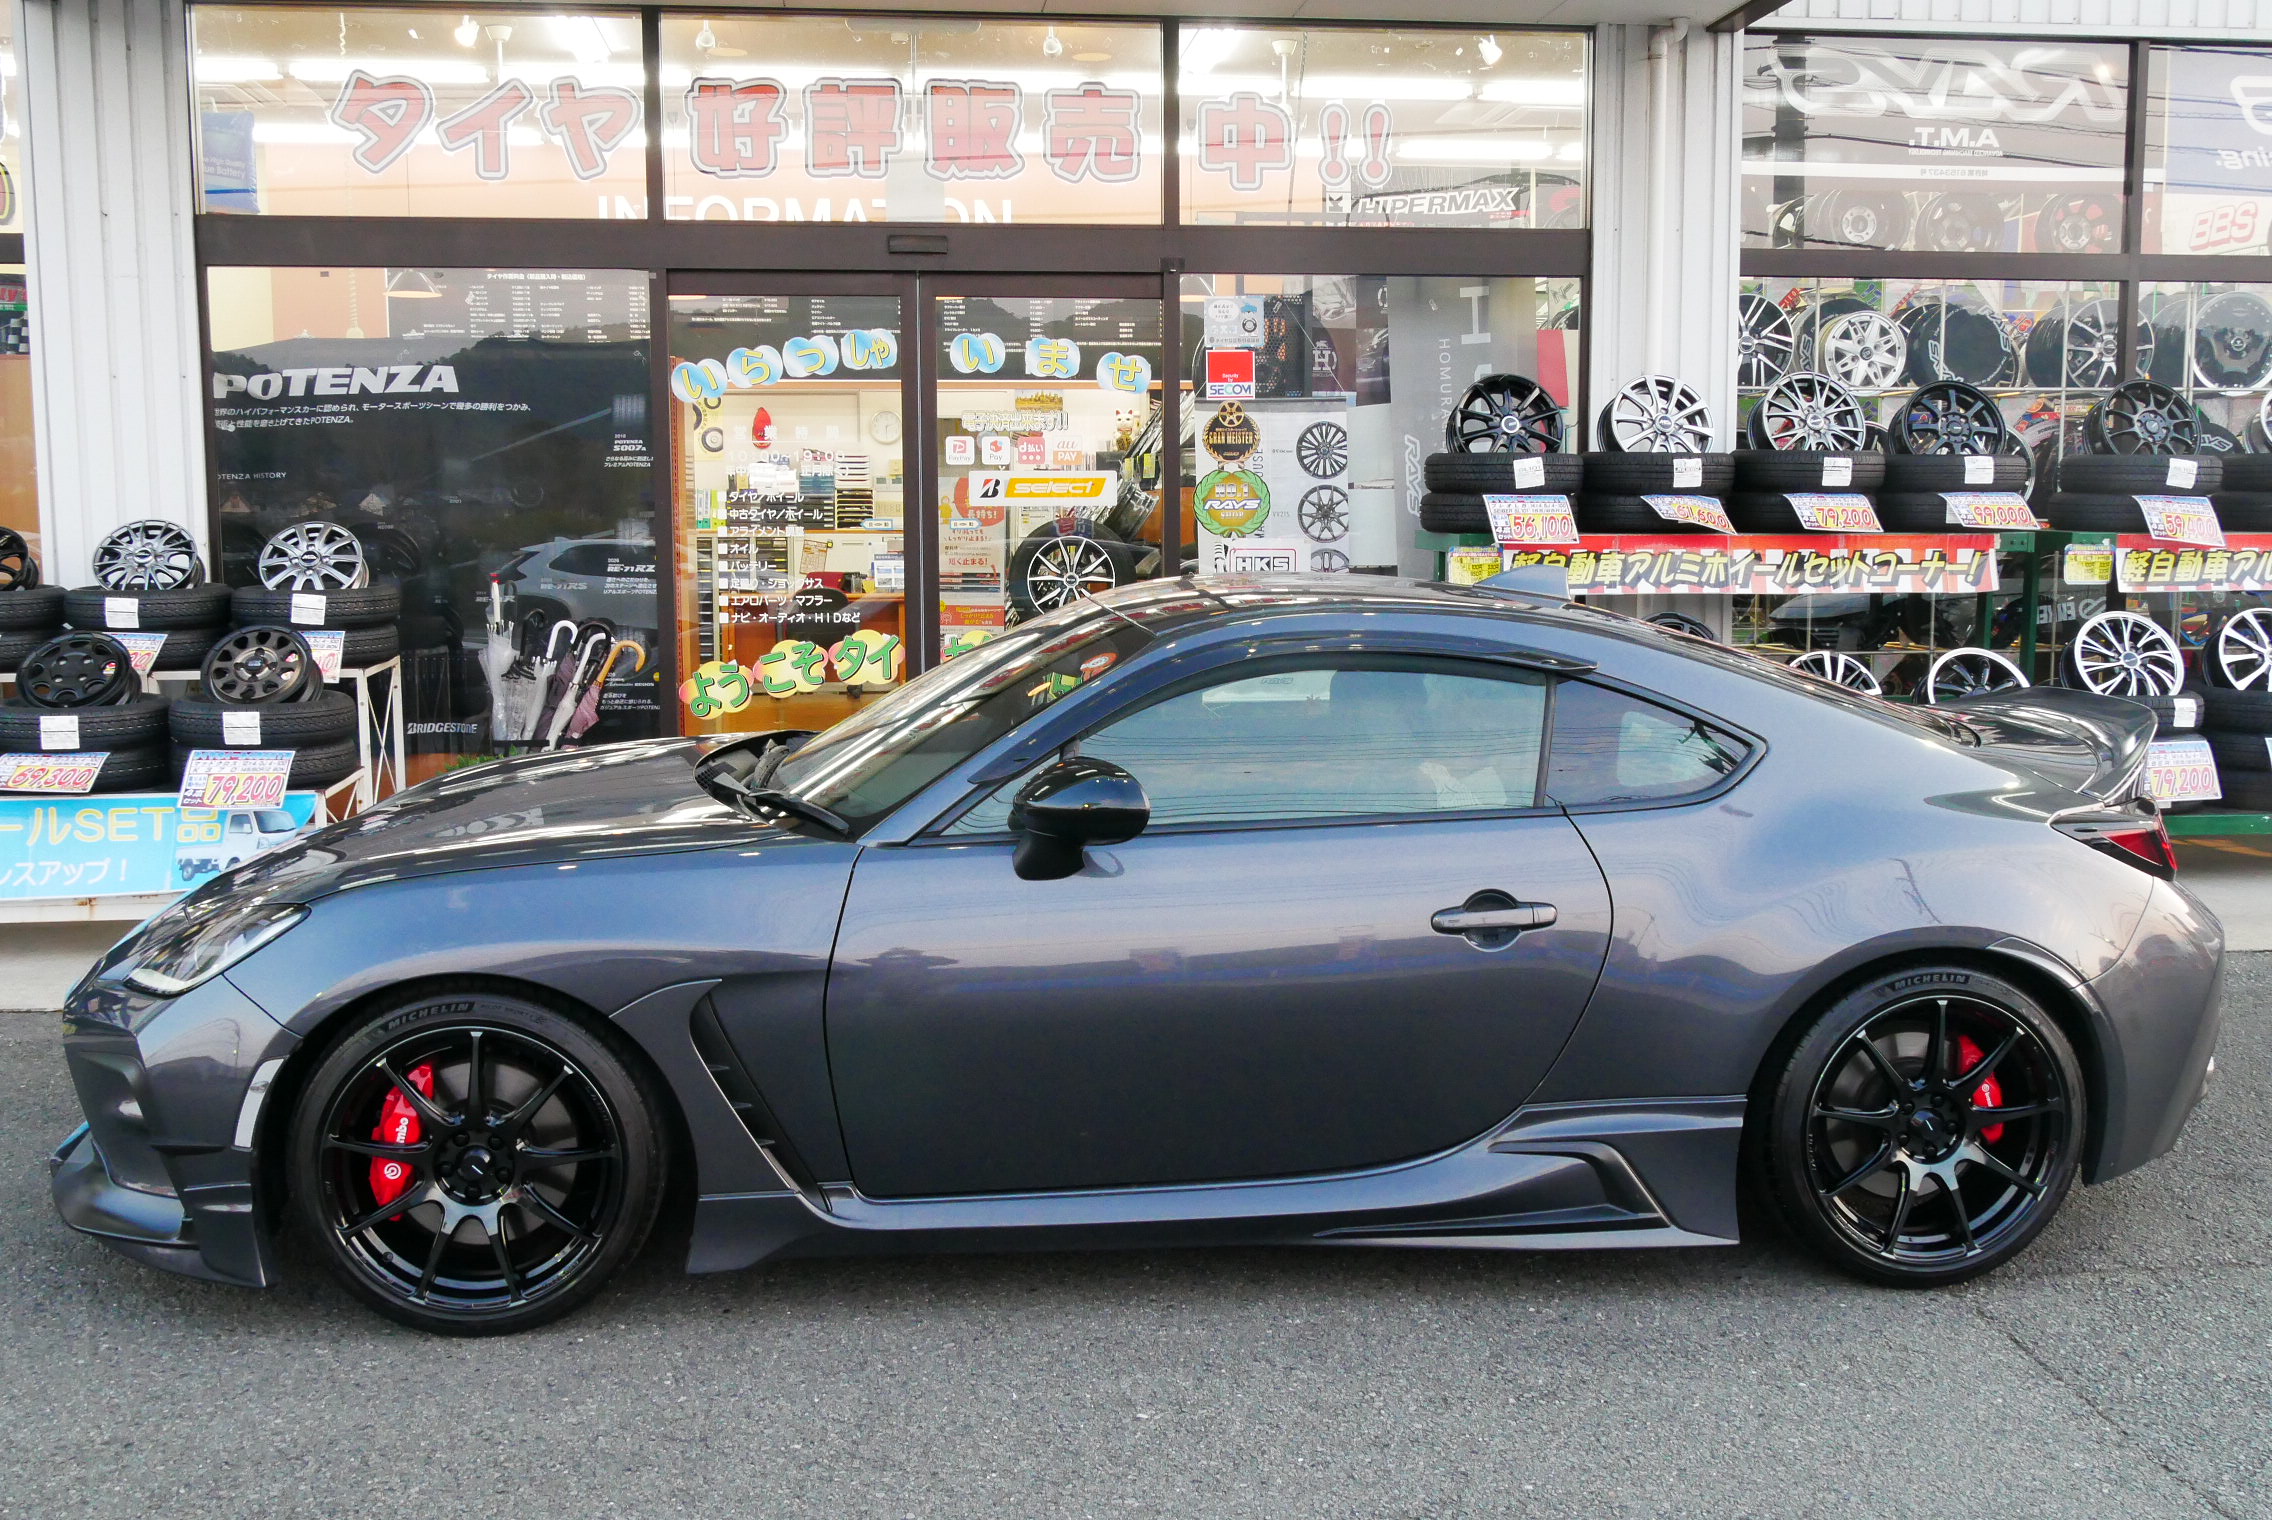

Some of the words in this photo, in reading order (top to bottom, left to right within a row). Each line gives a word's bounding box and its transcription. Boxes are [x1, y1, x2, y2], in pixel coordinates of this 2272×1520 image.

[2190, 201, 2258, 251] BBS
[213, 365, 459, 400] POTENZA
[1439, 338, 1452, 418] HOMURA
[1210, 384, 1251, 396] SECOM
[989, 454, 1003, 462] Pay
[1057, 452, 1077, 461] PAY
[253, 472, 287, 480] HISTORY
[1203, 499, 1262, 511] RAYS
[1675, 503, 1729, 529] 61,600
[1816, 507, 1874, 528] 79,200
[1972, 506, 2032, 525] 99,000
[1511, 514, 1573, 540] 56,100
[2165, 513, 2217, 540] 59,400
[730, 543, 759, 555] オイル
[730, 560, 777, 572] バッテリー
[1235, 556, 1290, 572] HKS
[731, 595, 833, 606] エアロパーツ・マフラー
[731, 612, 861, 624] ナビ・オーディオ・HIDなど
[407, 722, 479, 734] BRIDGESTONE
[11, 767, 95, 787] 69,300
[2153, 766, 2214, 796] 79,200
[208, 774, 285, 804] 79,200
[1894, 974, 1967, 990] MICHELIN
[387, 1002, 469, 1030] MICHELIN
[395, 1117, 410, 1144] mbo
